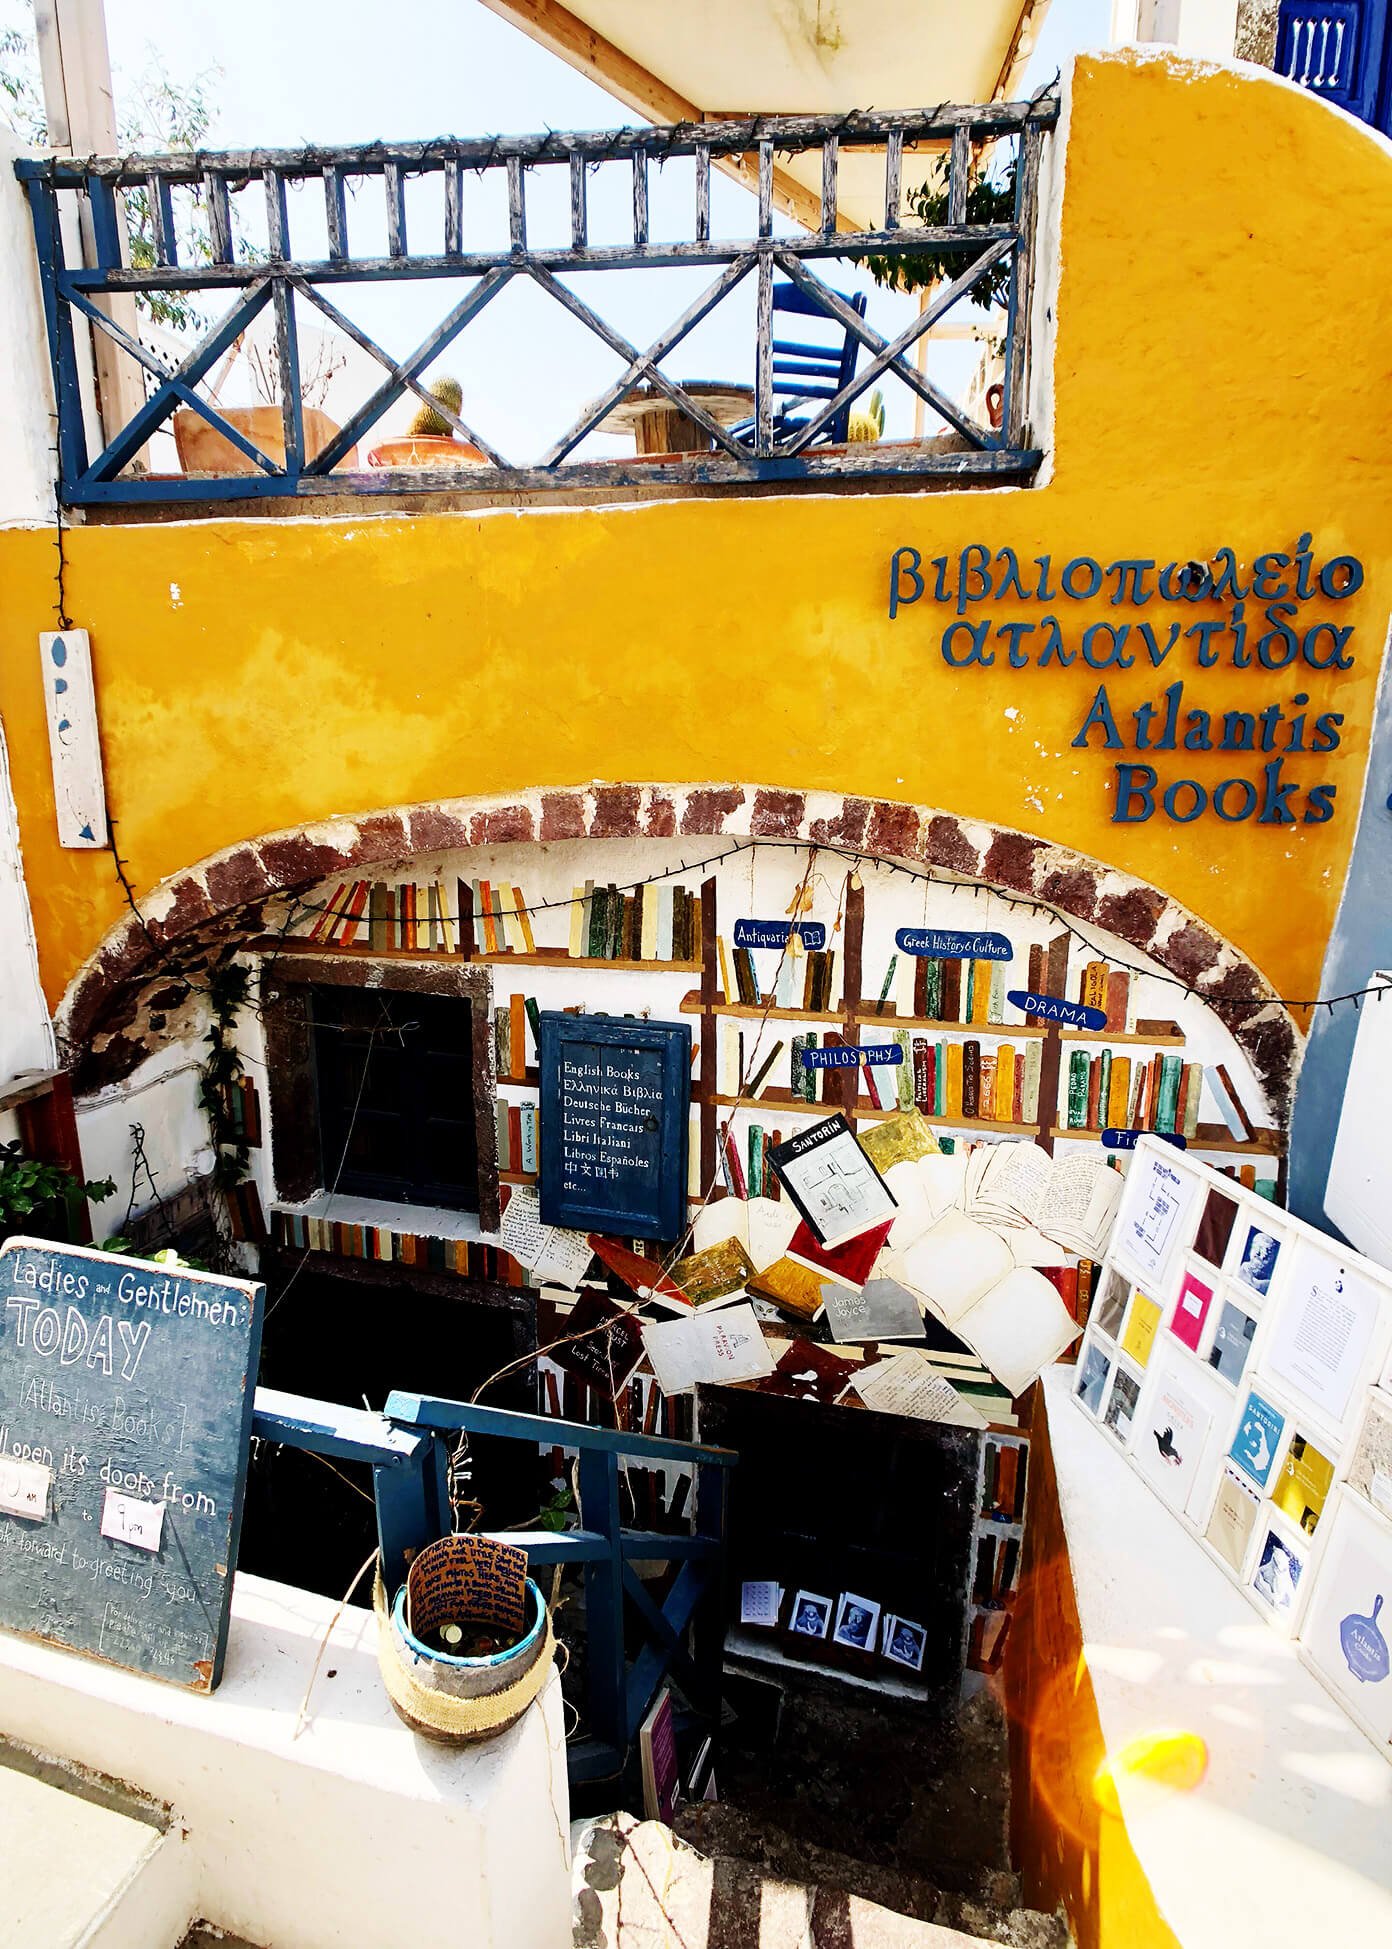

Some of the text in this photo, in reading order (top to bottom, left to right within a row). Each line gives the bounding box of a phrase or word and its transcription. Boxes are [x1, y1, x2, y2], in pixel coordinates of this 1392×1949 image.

[889, 531, 1365, 619] βιβλιοπωλείο
[941, 603, 1355, 670] ατλαντίδα
[1071, 681, 1345, 753] Atlantis
[1111, 756, 1337, 825] Books
[903, 934, 930, 949] Greek
[932, 934, 966, 955] History
[973, 937, 1008, 957] Culture
[1025, 996, 1087, 1025] DRAMA
[810, 1048, 893, 1067] PHILOSPHY
[564, 1061, 640, 1081] English Books
[564, 1096, 650, 1117] Deutsche Bücher
[564, 1113, 596, 1127] Livres
[564, 1130, 631, 1149] Libri Italiani
[564, 1147, 649, 1168] Libros Españoles
[14, 1254, 89, 1298] Ladies
[95, 1283, 111, 1294] and
[832, 1296, 866, 1308] James
[836, 1305, 866, 1318] Joyce
[7, 1296, 151, 1382] TODAY
[600, 1316, 629, 1341] MRCEL
[571, 1344, 590, 1362] Lost
[13, 1442, 53, 1466] open
[64, 1445, 89, 1476] its
[100, 1456, 155, 1496] doors
[162, 1471, 216, 1516] from
[82, 1509, 93, 1521] to
[89, 1557, 153, 1603] greeting
[1350, 1628, 1381, 1662] Atlantis
